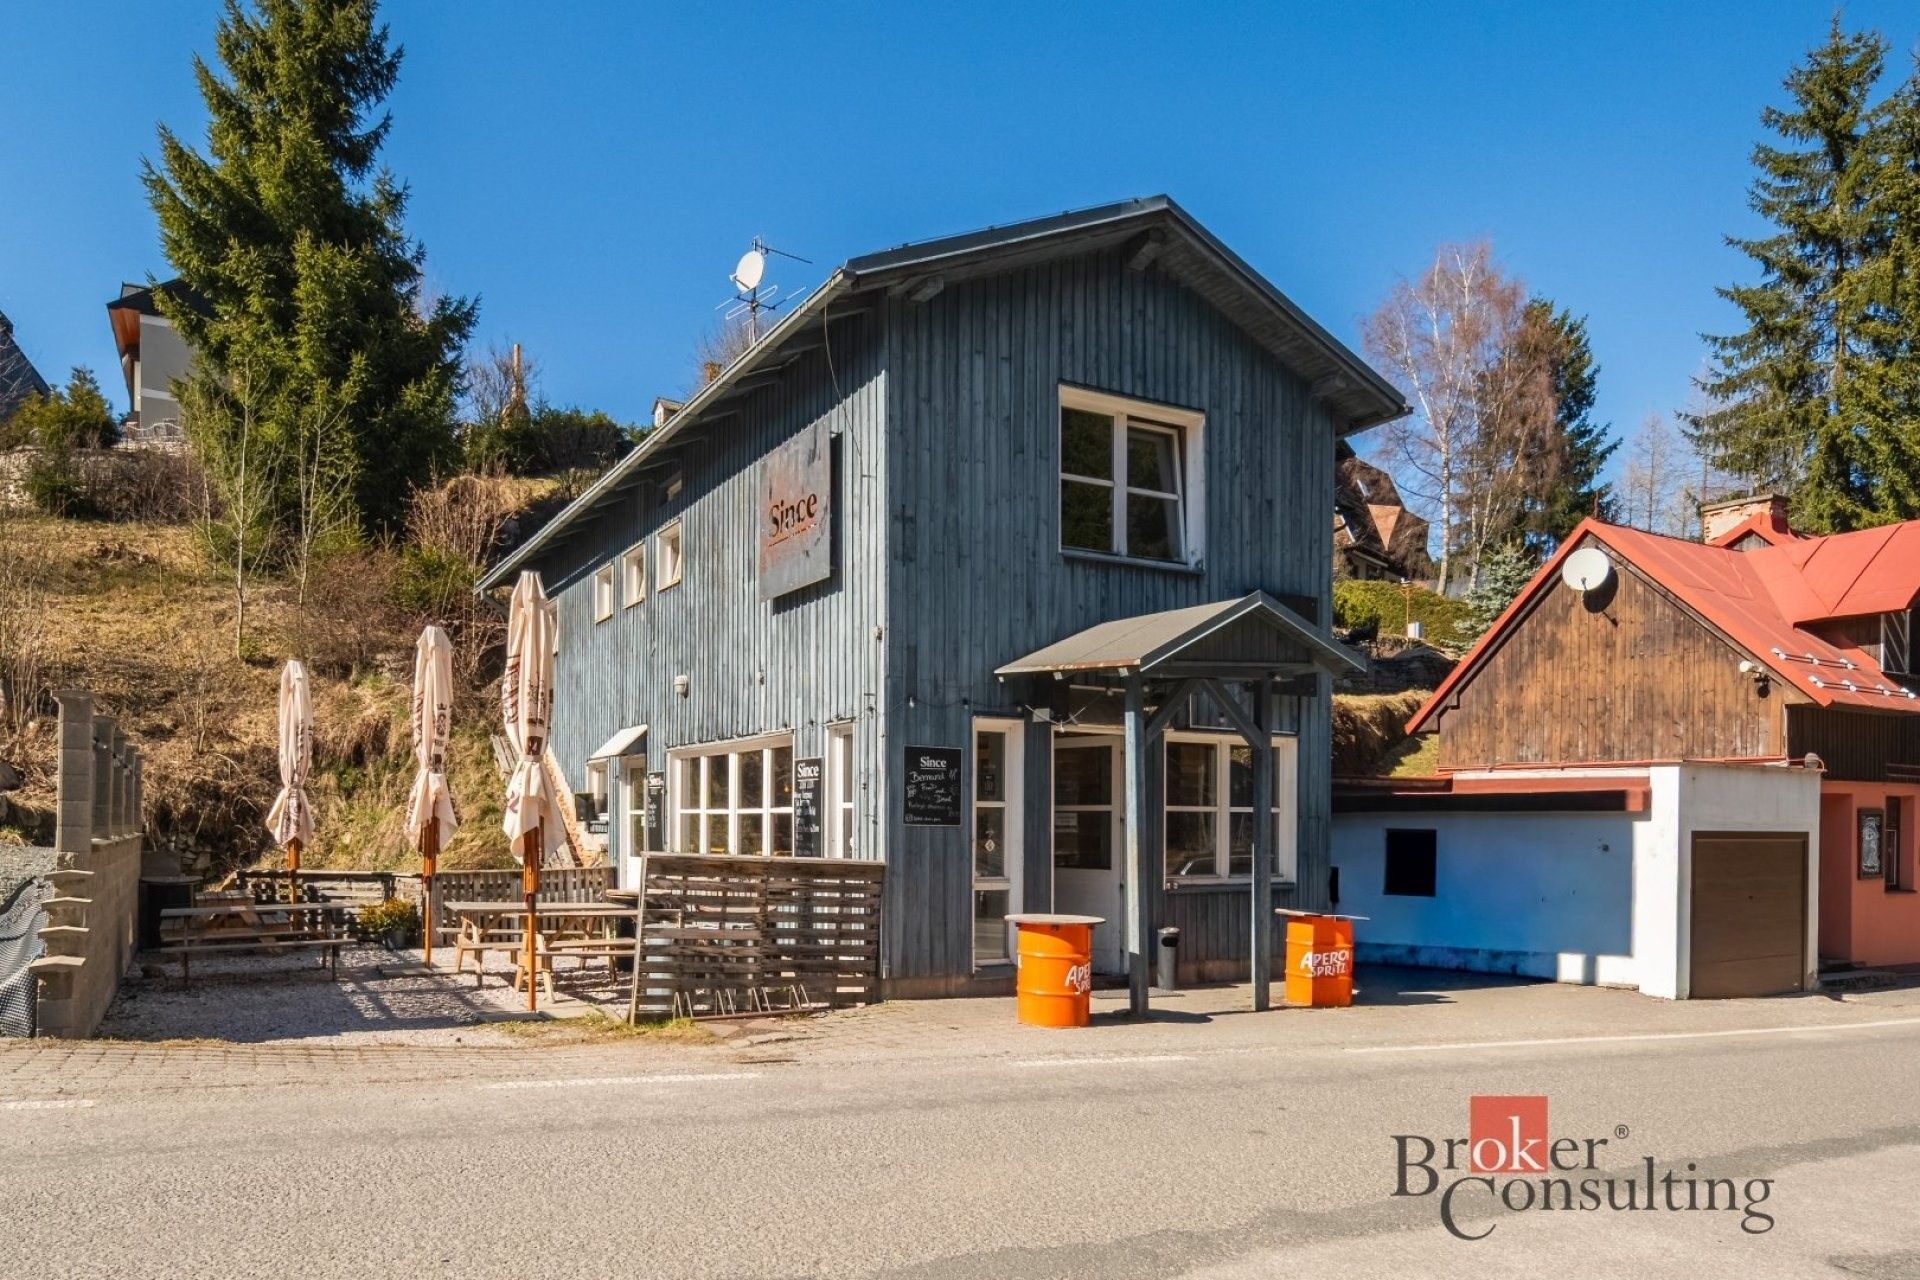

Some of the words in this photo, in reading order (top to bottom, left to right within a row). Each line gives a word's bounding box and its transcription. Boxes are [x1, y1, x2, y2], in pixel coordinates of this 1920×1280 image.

[769, 493, 818, 538] Since
[920, 755, 947, 768] Since
[797, 762, 819, 777] Since
